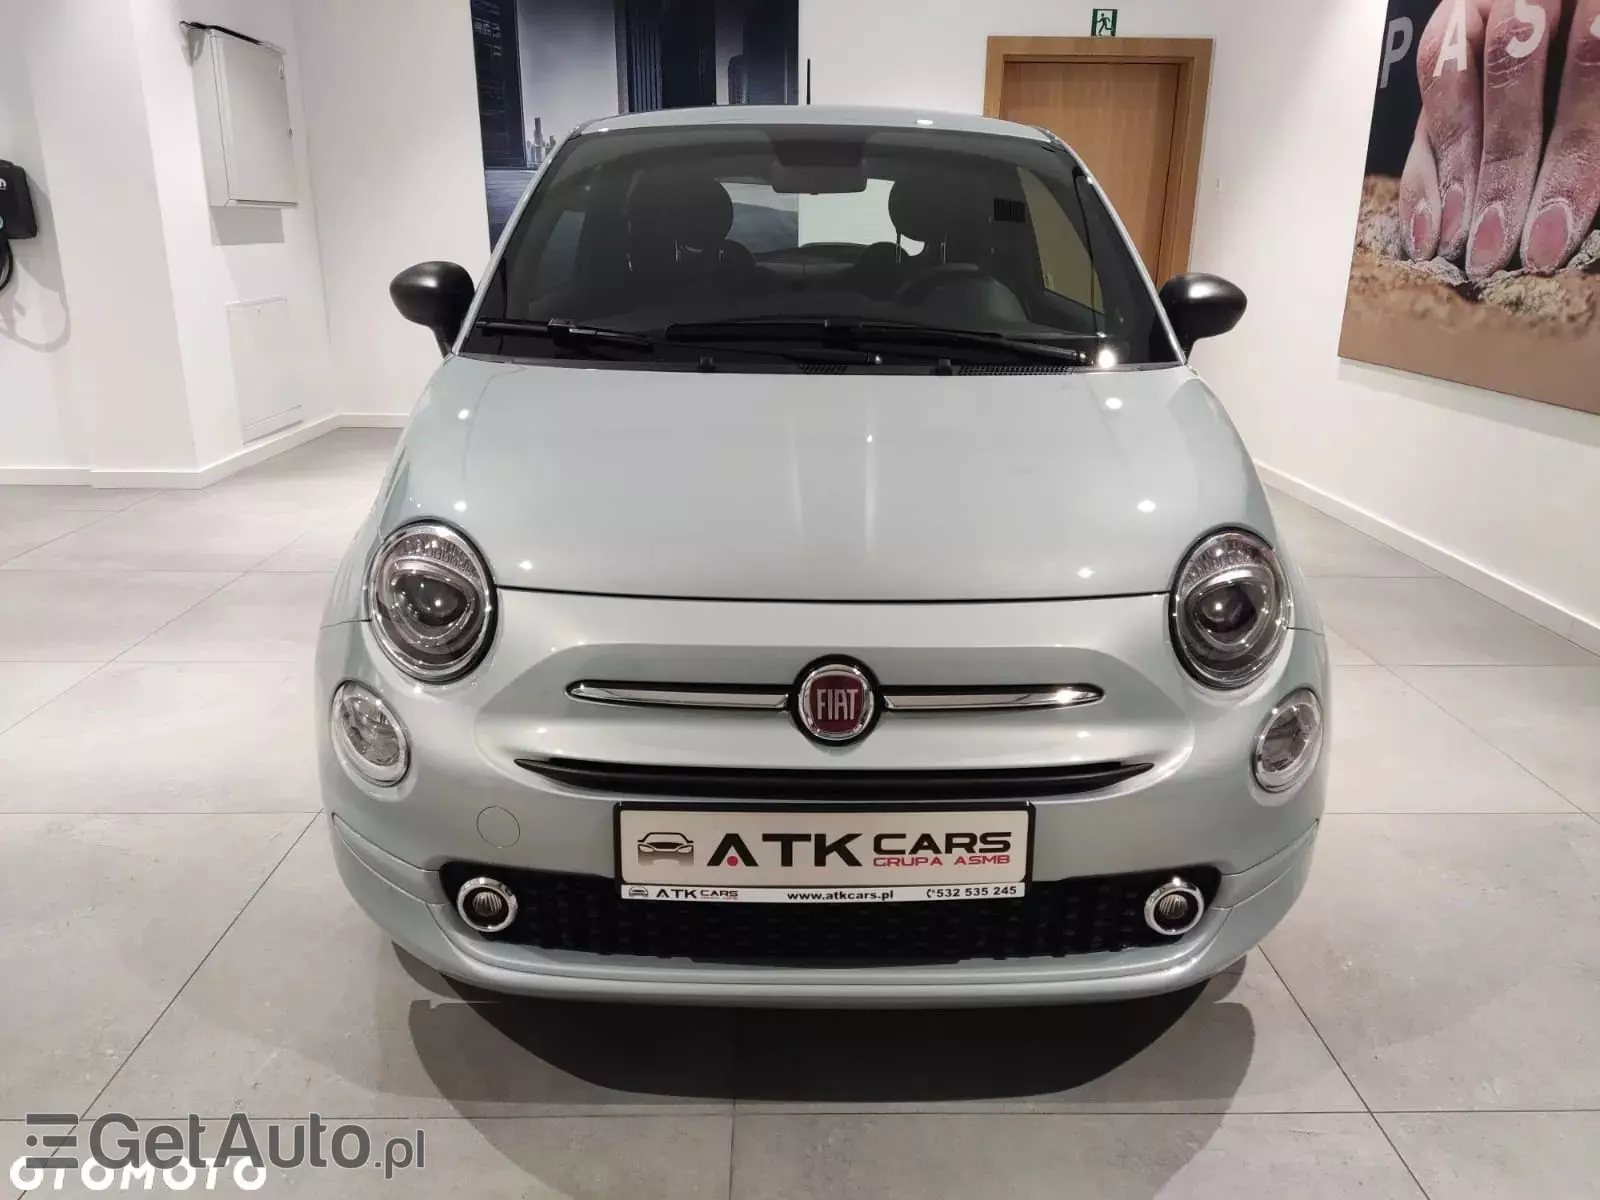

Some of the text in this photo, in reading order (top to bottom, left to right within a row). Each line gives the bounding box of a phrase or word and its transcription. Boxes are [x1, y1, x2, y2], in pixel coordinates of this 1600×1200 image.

[1379, 0, 1600, 89] PAS
[816, 688, 859, 721] FIAT
[706, 831, 1012, 867] ATK CARS
[873, 854, 1010, 867] GRUPA ASMB
[656, 888, 697, 899] ATK
[700, 889, 739, 897] CARS
[787, 889, 894, 902] www.atkcars.pl
[936, 885, 1017, 898] 532 535 245
